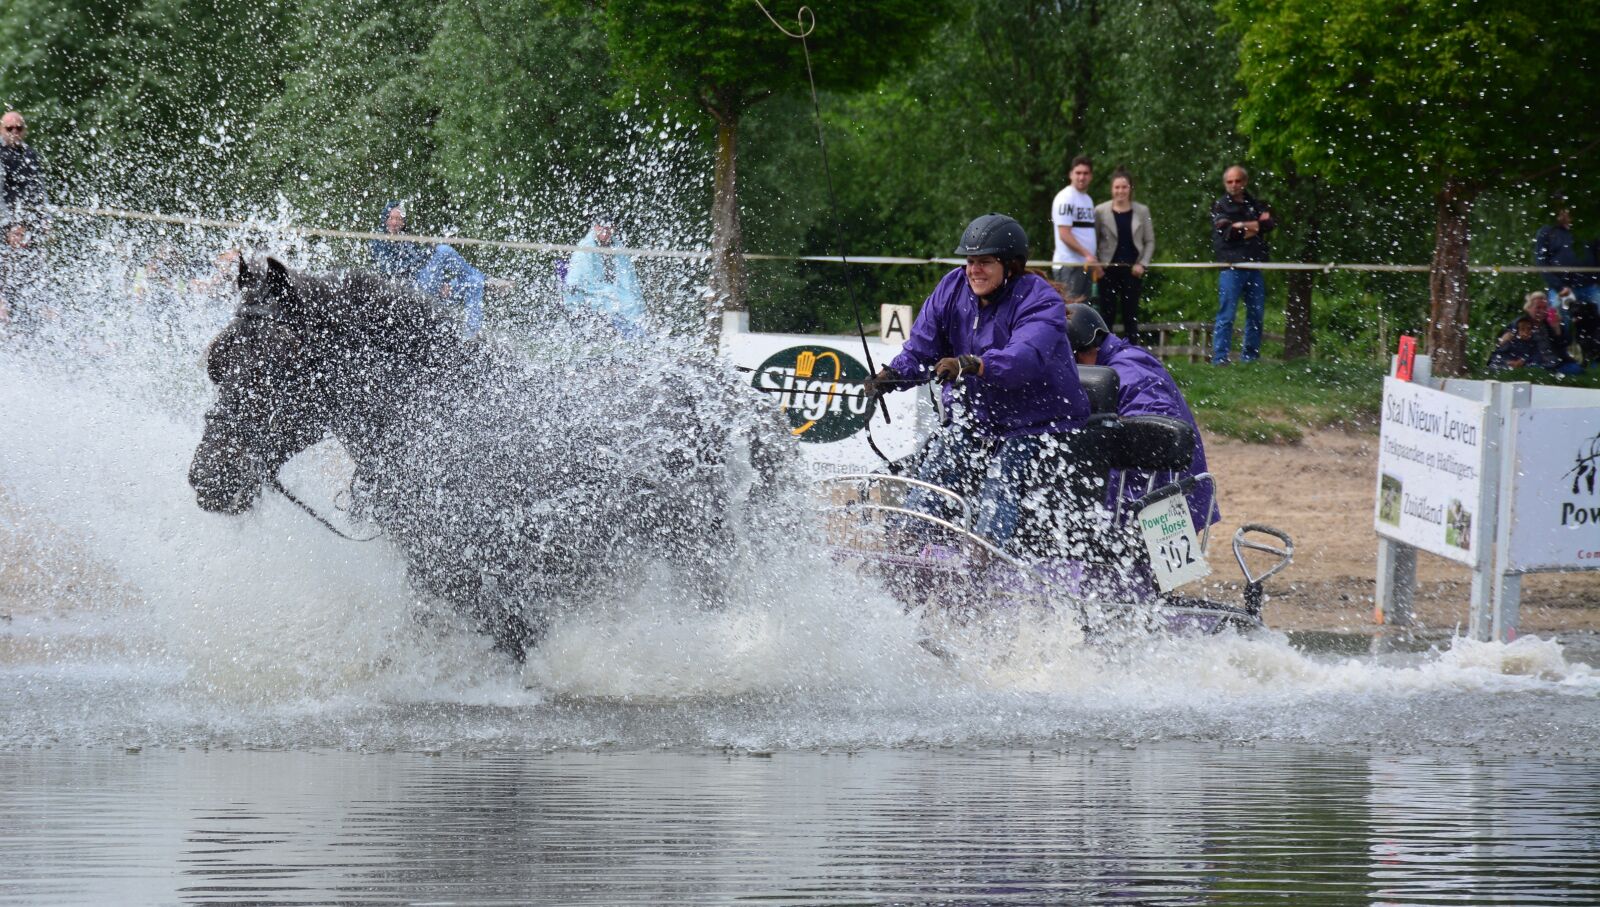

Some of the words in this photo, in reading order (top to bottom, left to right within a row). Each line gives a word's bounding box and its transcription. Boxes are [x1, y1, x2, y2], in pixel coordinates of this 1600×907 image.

[886, 310, 905, 340] A
[1386, 393, 1405, 423] Stal
[1407, 395, 1441, 436] Nieuw
[1443, 409, 1477, 447] Leven
[1427, 453, 1435, 468] en
[1142, 513, 1169, 531] Power
[1404, 492, 1444, 526] Zuidland
[1160, 519, 1187, 536] Horse
[1160, 535, 1195, 573] 102
